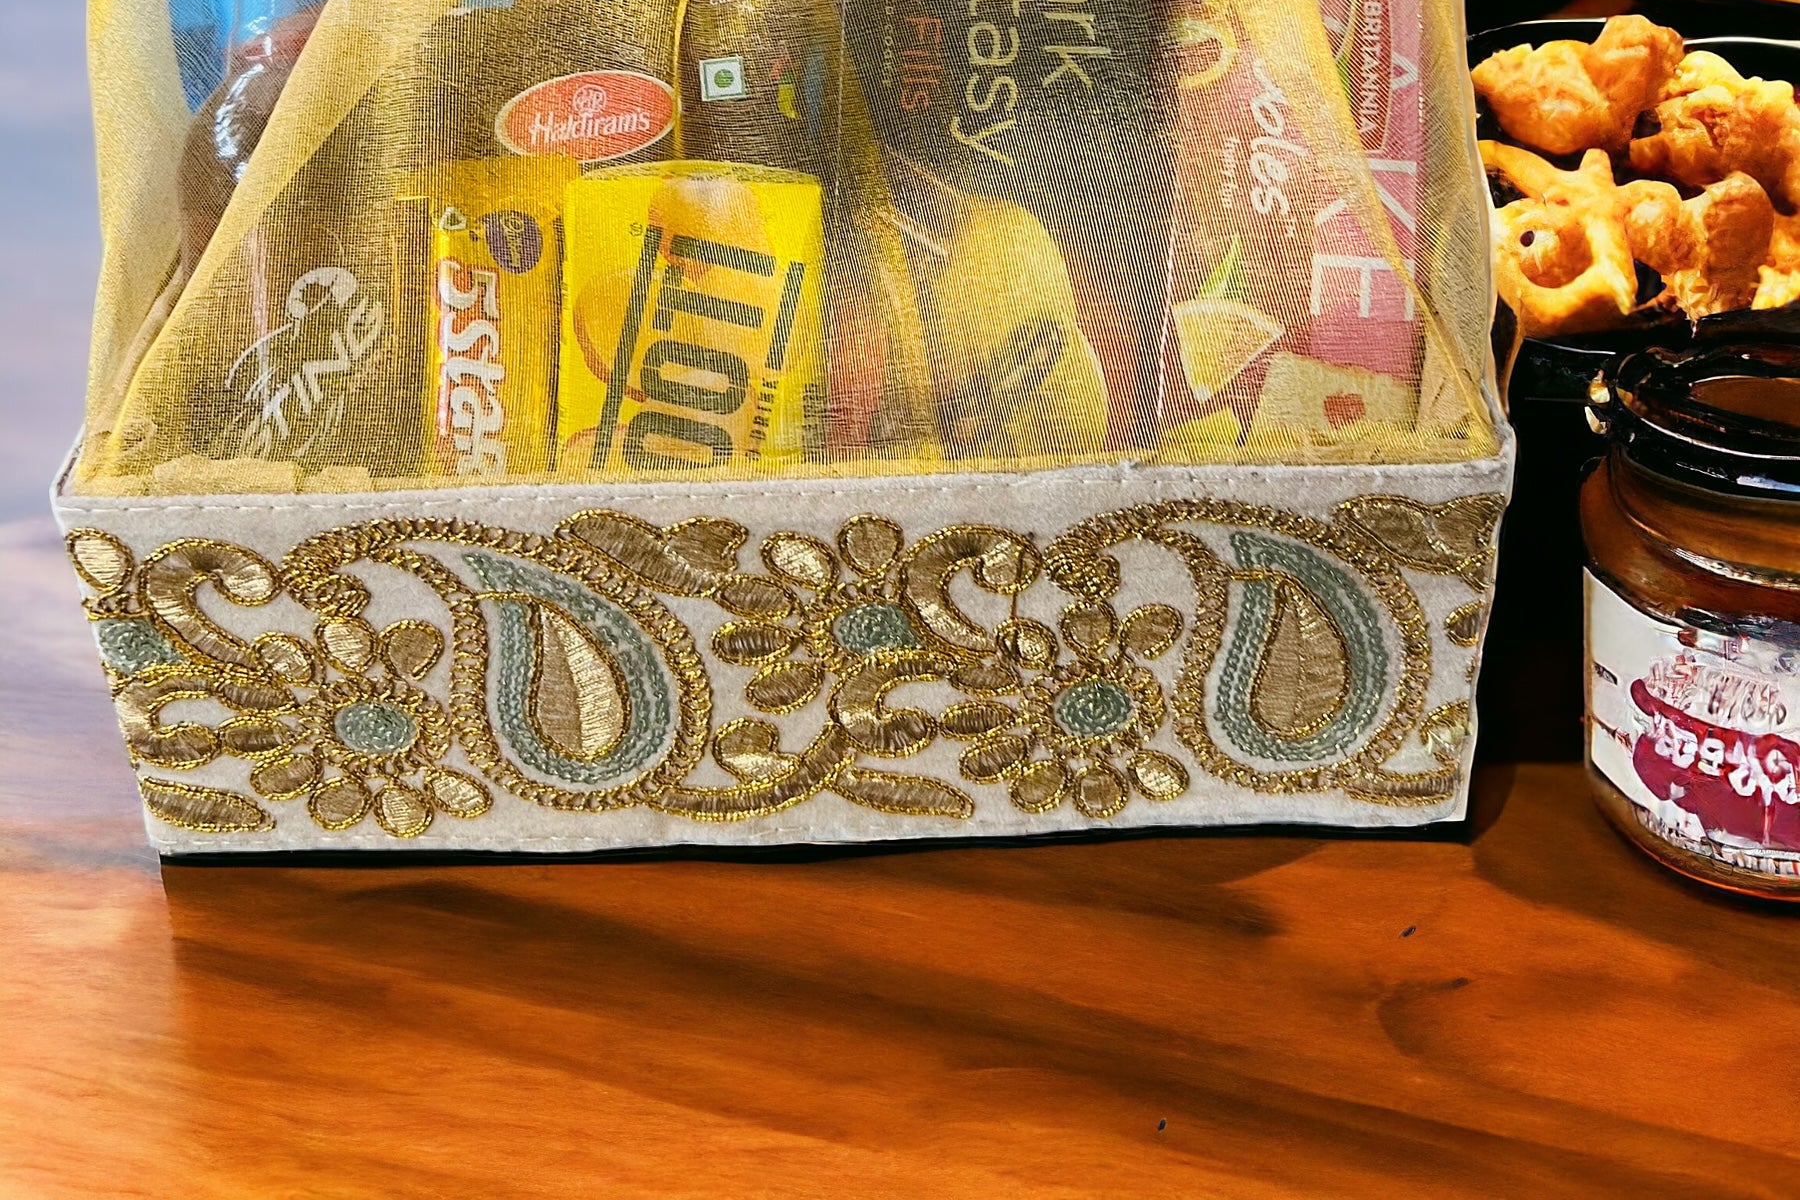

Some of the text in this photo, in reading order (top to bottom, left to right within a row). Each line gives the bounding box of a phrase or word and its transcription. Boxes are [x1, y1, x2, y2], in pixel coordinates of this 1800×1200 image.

[901, 16, 943, 112] Fills
[1359, 0, 1384, 136] BRITANNIA
[528, 108, 651, 146] Haldiram's
[622, 234, 777, 471] OOTI
